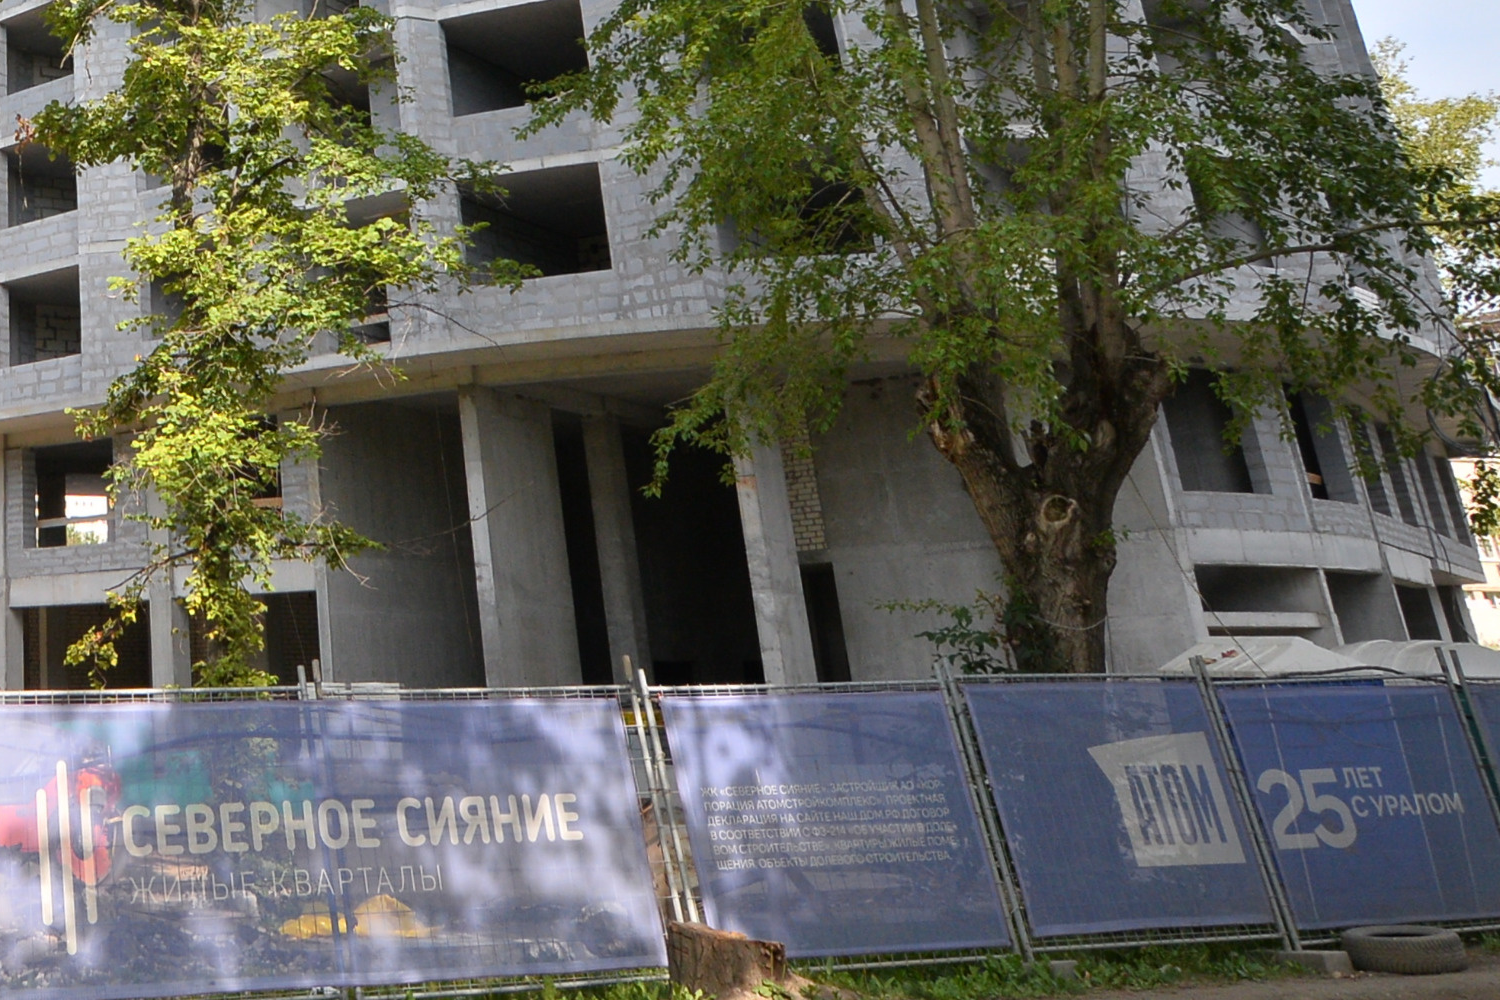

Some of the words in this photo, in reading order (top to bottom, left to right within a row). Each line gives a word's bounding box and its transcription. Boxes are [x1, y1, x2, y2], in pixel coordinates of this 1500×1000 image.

[1342, 766, 1383, 789] ЛЕТ
[700, 787, 718, 798] ЖК
[704, 800, 755, 813] ПОРАЦИЯ
[885, 793, 945, 805] ПРОЕКТНАЯ
[1256, 767, 1358, 850] 25
[1353, 795, 1369, 818] С
[1371, 793, 1465, 817] УРАЛОМ
[121, 799, 382, 857] СЕВЕРНОЕ
[398, 793, 585, 847] СИЯНИЕ
[707, 813, 778, 827] ДЕКЛАРАЦИЯ
[780, 813, 795, 824] НА
[797, 810, 831, 824] САЙТЕ
[710, 830, 718, 841] В
[719, 827, 802, 841] СООТВЕТСТВИИ
[802, 826, 810, 838] С
[713, 843, 738, 856] ВОМ
[759, 856, 808, 870] ОБЪЕКТЫ
[810, 853, 864, 868] ДОЛЕВОГО
[272, 863, 444, 898] КВАРТАЛЫ
